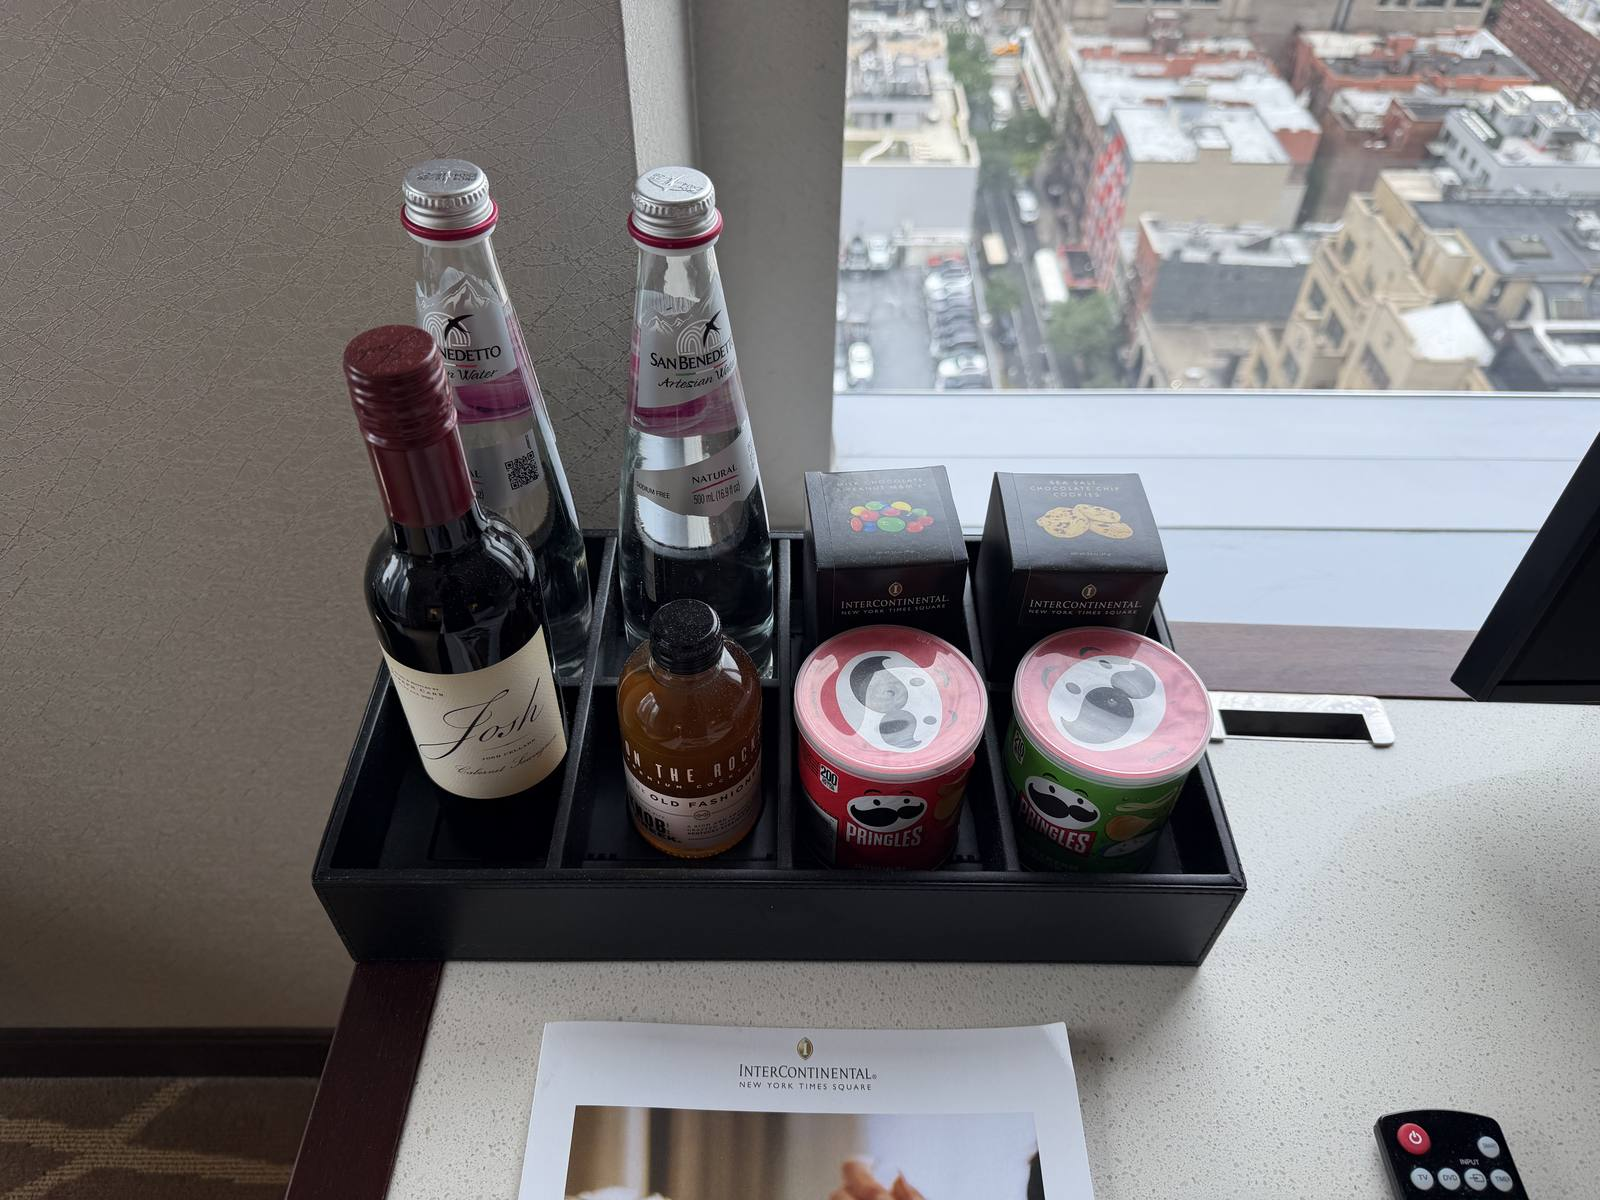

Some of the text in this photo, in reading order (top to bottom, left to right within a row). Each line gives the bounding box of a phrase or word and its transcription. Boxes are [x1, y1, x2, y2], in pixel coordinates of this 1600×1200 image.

[437, 345, 501, 361] NEDETTO
[650, 352, 677, 370] SAN
[457, 368, 496, 381] Water
[658, 376, 713, 389] Artesian
[691, 463, 738, 484] NATURAL
[656, 489, 671, 500] FREE
[693, 493, 705, 505] 500
[705, 492, 716, 503] mL
[841, 594, 948, 609] INTERCONTINENTAL
[914, 603, 946, 611] SQUARE
[1029, 599, 1141, 609] INTERCONTINENTAL
[418, 677, 544, 760] Josh
[655, 763, 695, 783] THE
[714, 734, 757, 778] ROCK
[820, 765, 838, 786] 200
[650, 793, 680, 808] OLD
[1019, 796, 1091, 854] PRINGLES
[846, 821, 923, 848] PRINGLES
[767, 1082, 794, 1090] YORK
[799, 1082, 828, 1090] TIMES
[832, 1083, 872, 1091] SQUARE
[1459, 1158, 1480, 1166] INPUT
[1443, 1174, 1458, 1182] DVD
